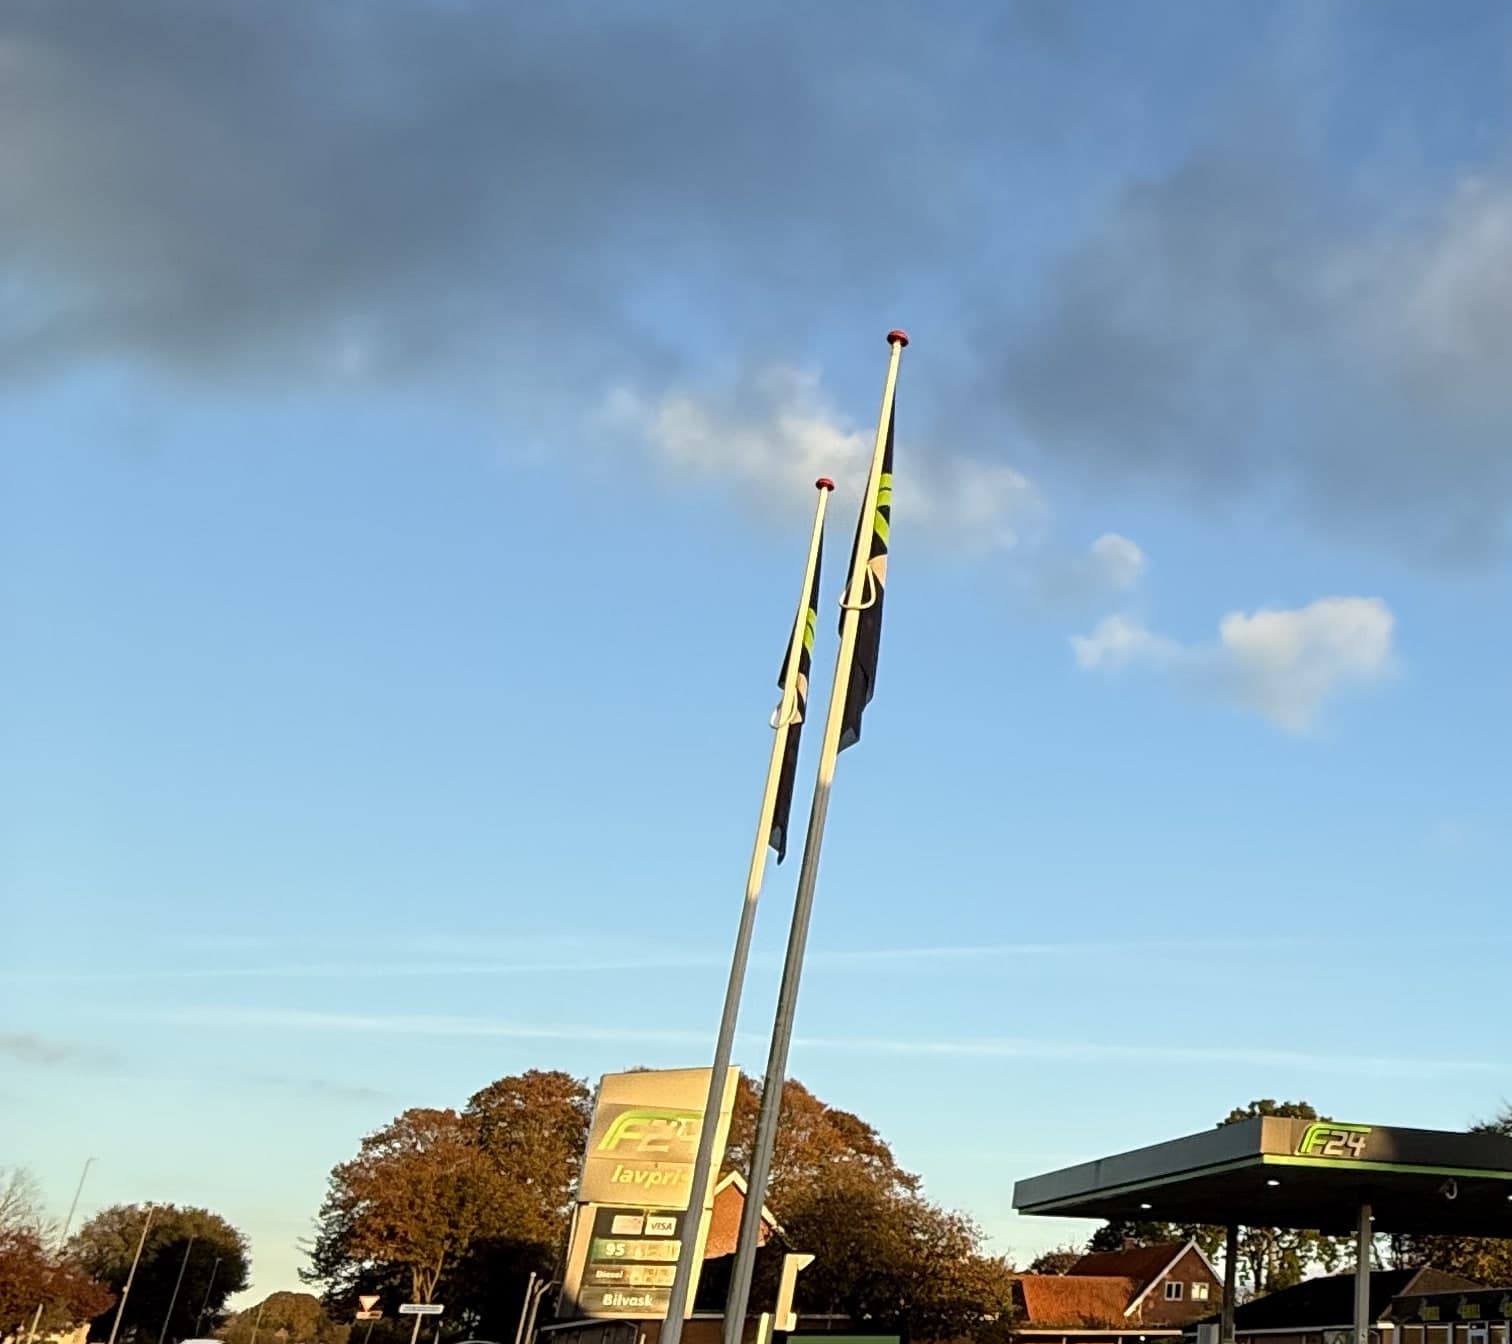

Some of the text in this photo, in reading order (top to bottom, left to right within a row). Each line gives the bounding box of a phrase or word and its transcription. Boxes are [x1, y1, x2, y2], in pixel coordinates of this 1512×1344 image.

[1296, 1122, 1372, 1157] F24
[651, 1222, 673, 1230] VISA
[605, 1242, 626, 1256] 95
[595, 1270, 624, 1279] Diesel
[602, 1293, 653, 1307] Bilvask
